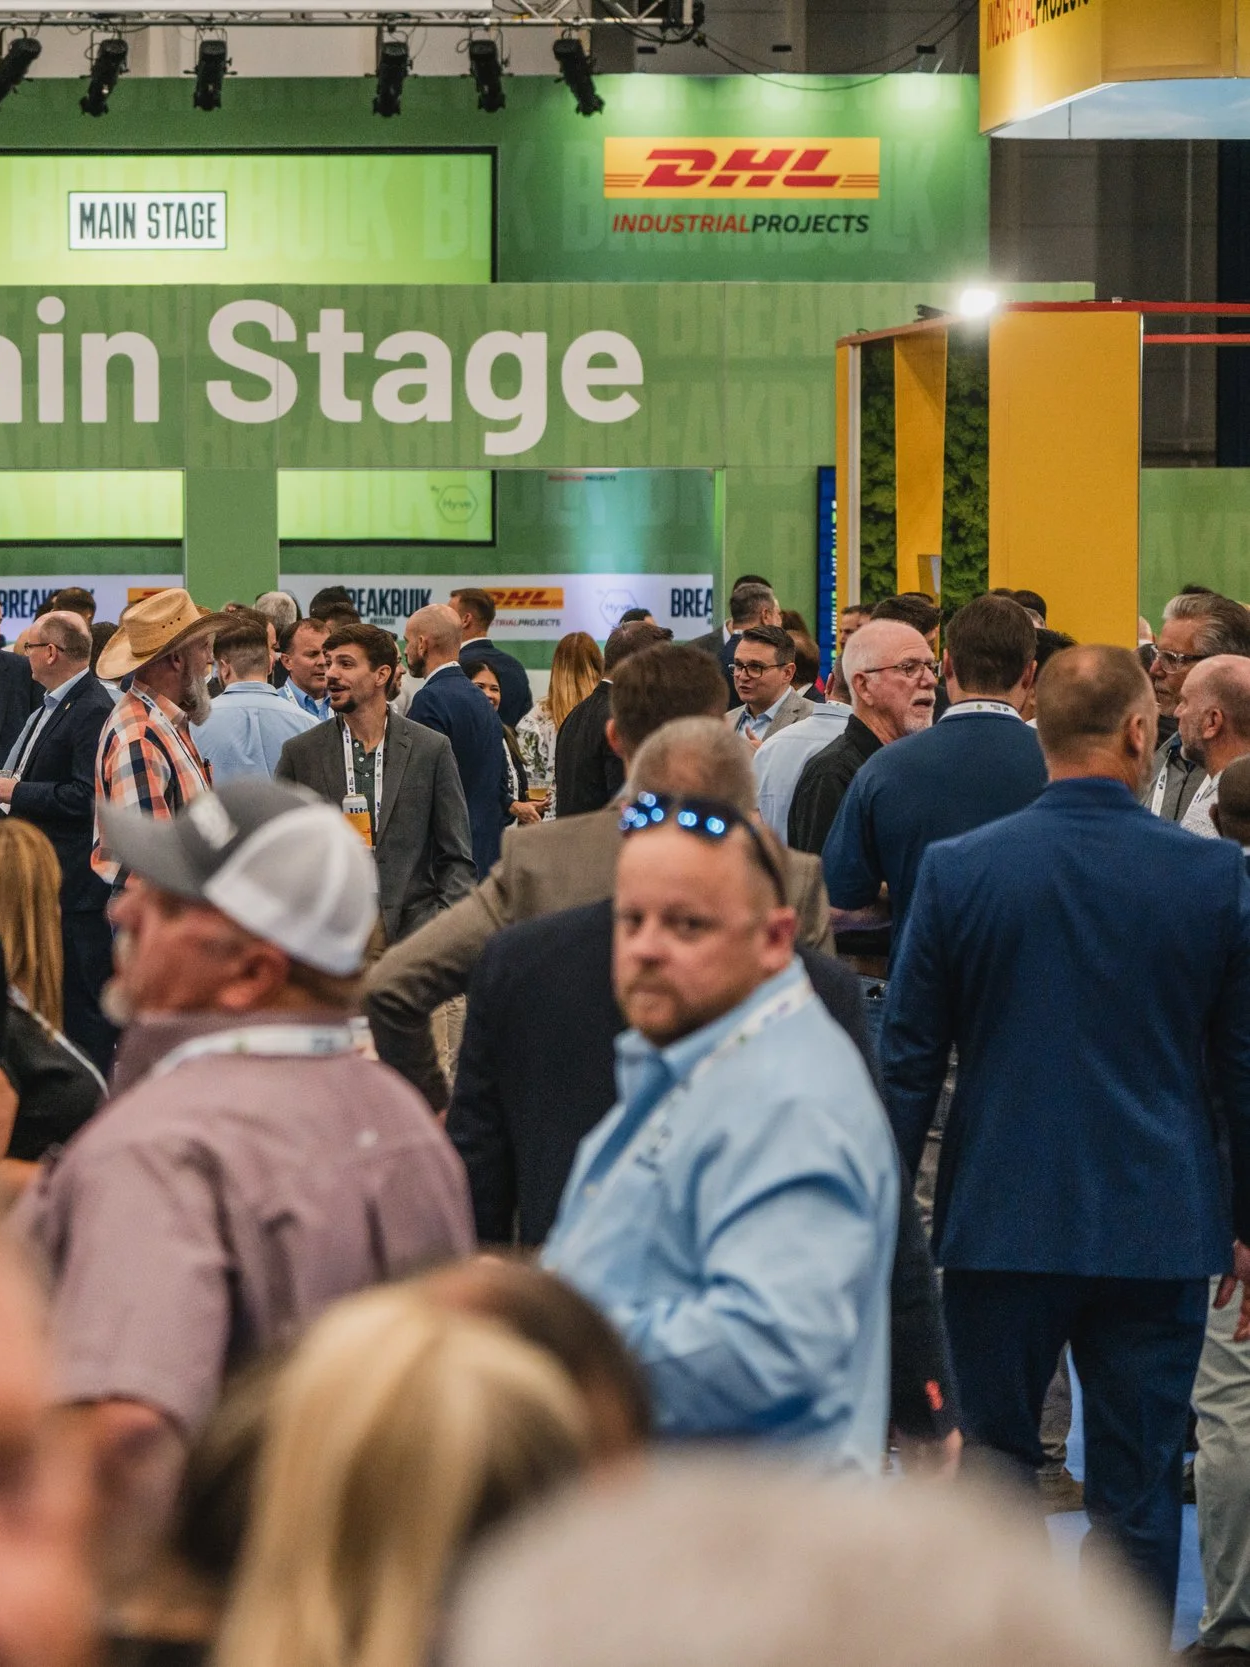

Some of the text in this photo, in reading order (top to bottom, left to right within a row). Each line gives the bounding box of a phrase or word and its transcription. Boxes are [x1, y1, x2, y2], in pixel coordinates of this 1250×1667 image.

[987, 0, 1089, 50] INDUSTRIALPR
[643, 148, 841, 188] DHL
[79, 202, 217, 240] MAIN STAGE
[613, 213, 869, 234] INDUSTRIALPROJECTS
[205, 300, 644, 456] Stage
